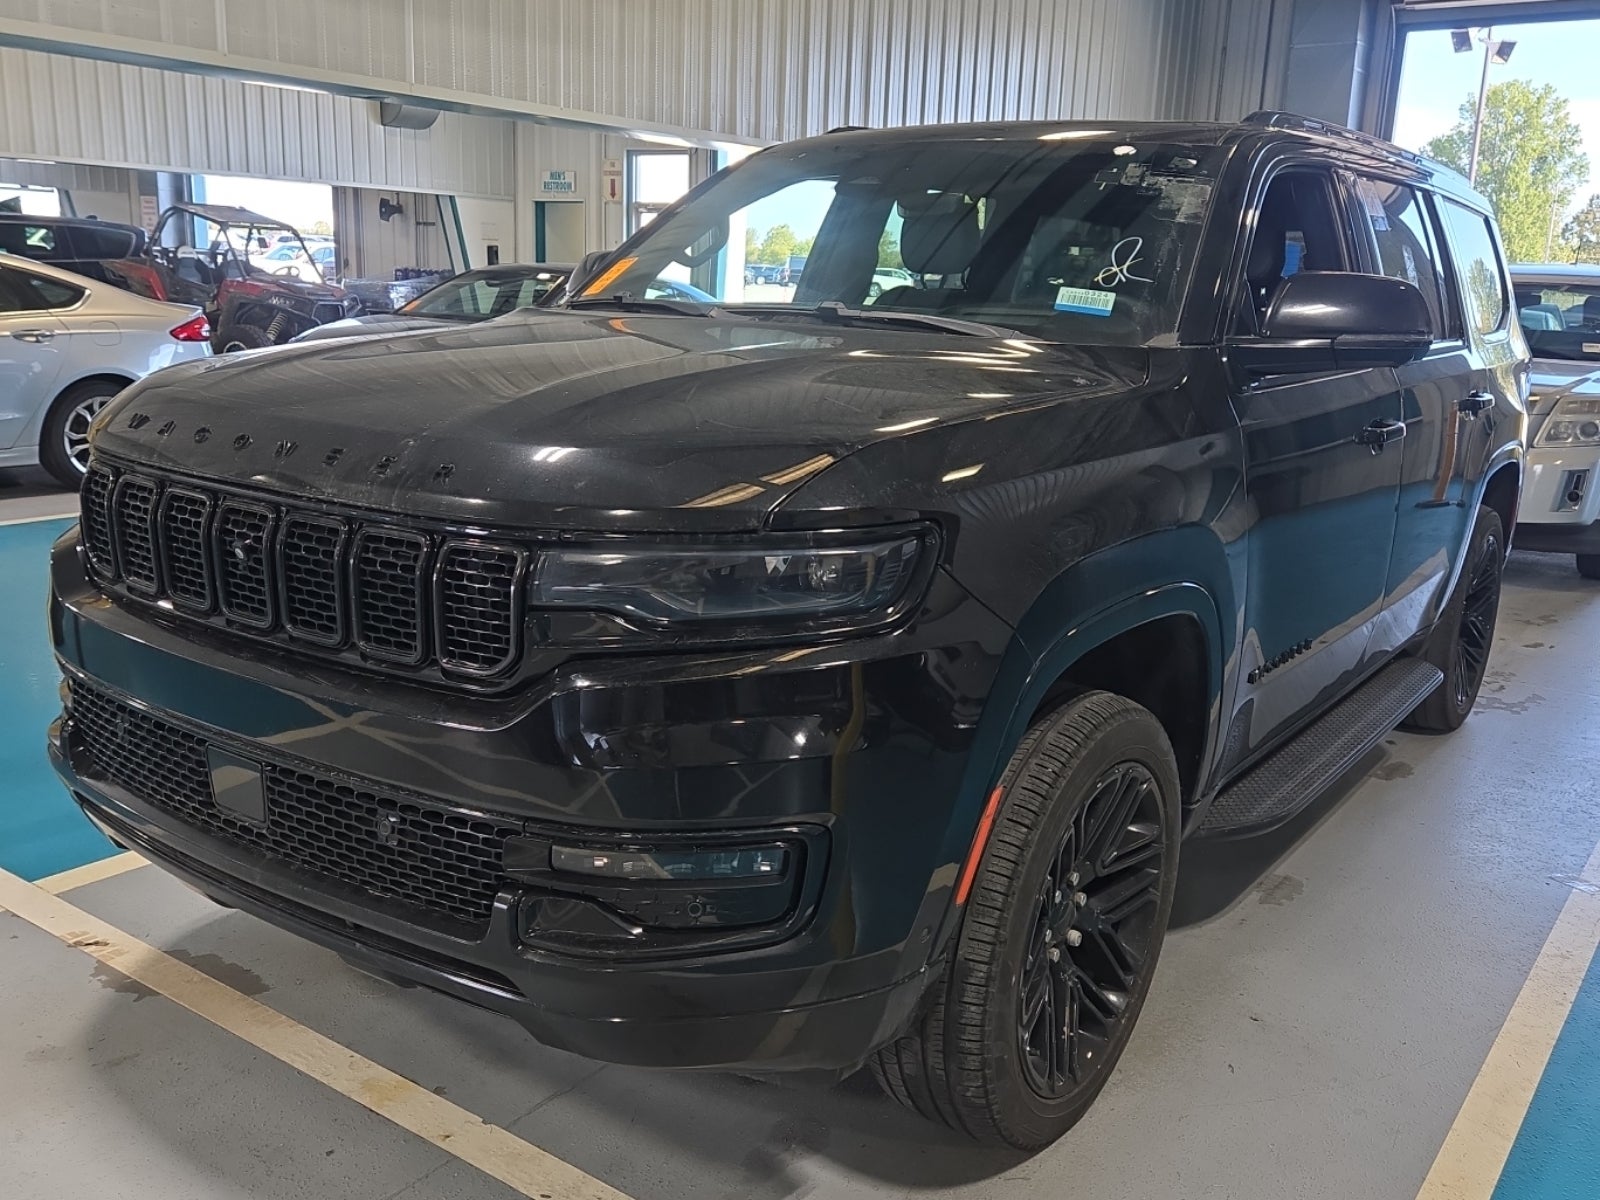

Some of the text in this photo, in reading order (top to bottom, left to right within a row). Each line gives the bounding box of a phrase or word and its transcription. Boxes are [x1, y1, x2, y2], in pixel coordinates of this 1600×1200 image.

[549, 171, 566, 181] MEN'S
[543, 181, 573, 191] RESTROOM
[127, 411, 456, 486] WAGONEER
